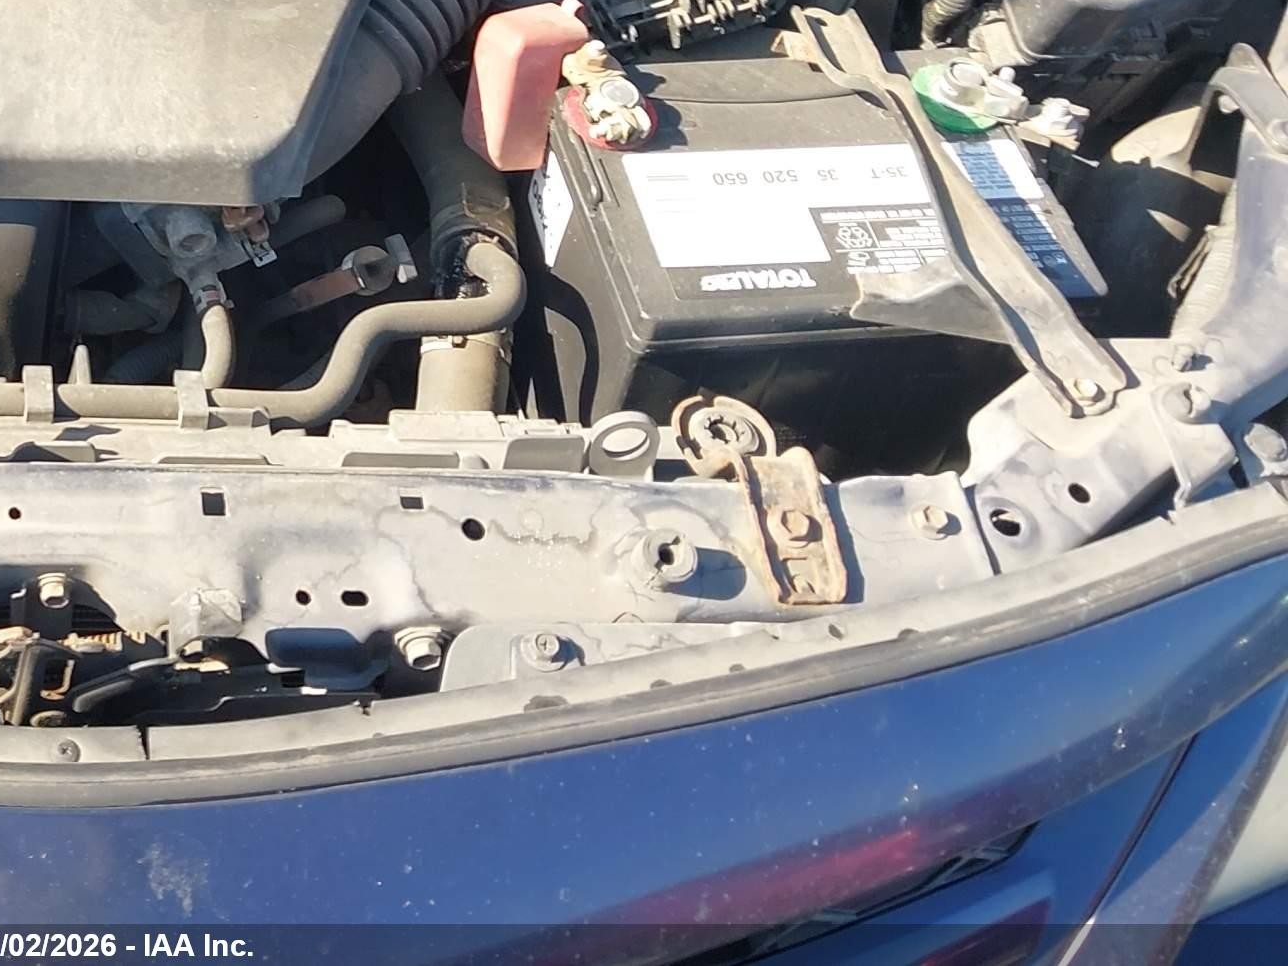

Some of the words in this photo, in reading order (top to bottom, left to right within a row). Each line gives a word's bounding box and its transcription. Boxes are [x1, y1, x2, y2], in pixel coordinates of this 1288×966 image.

[711, 171, 749, 186] 650
[762, 168, 800, 184] 520
[816, 167, 840, 182] 35
[870, 165, 908, 180] 35-T
